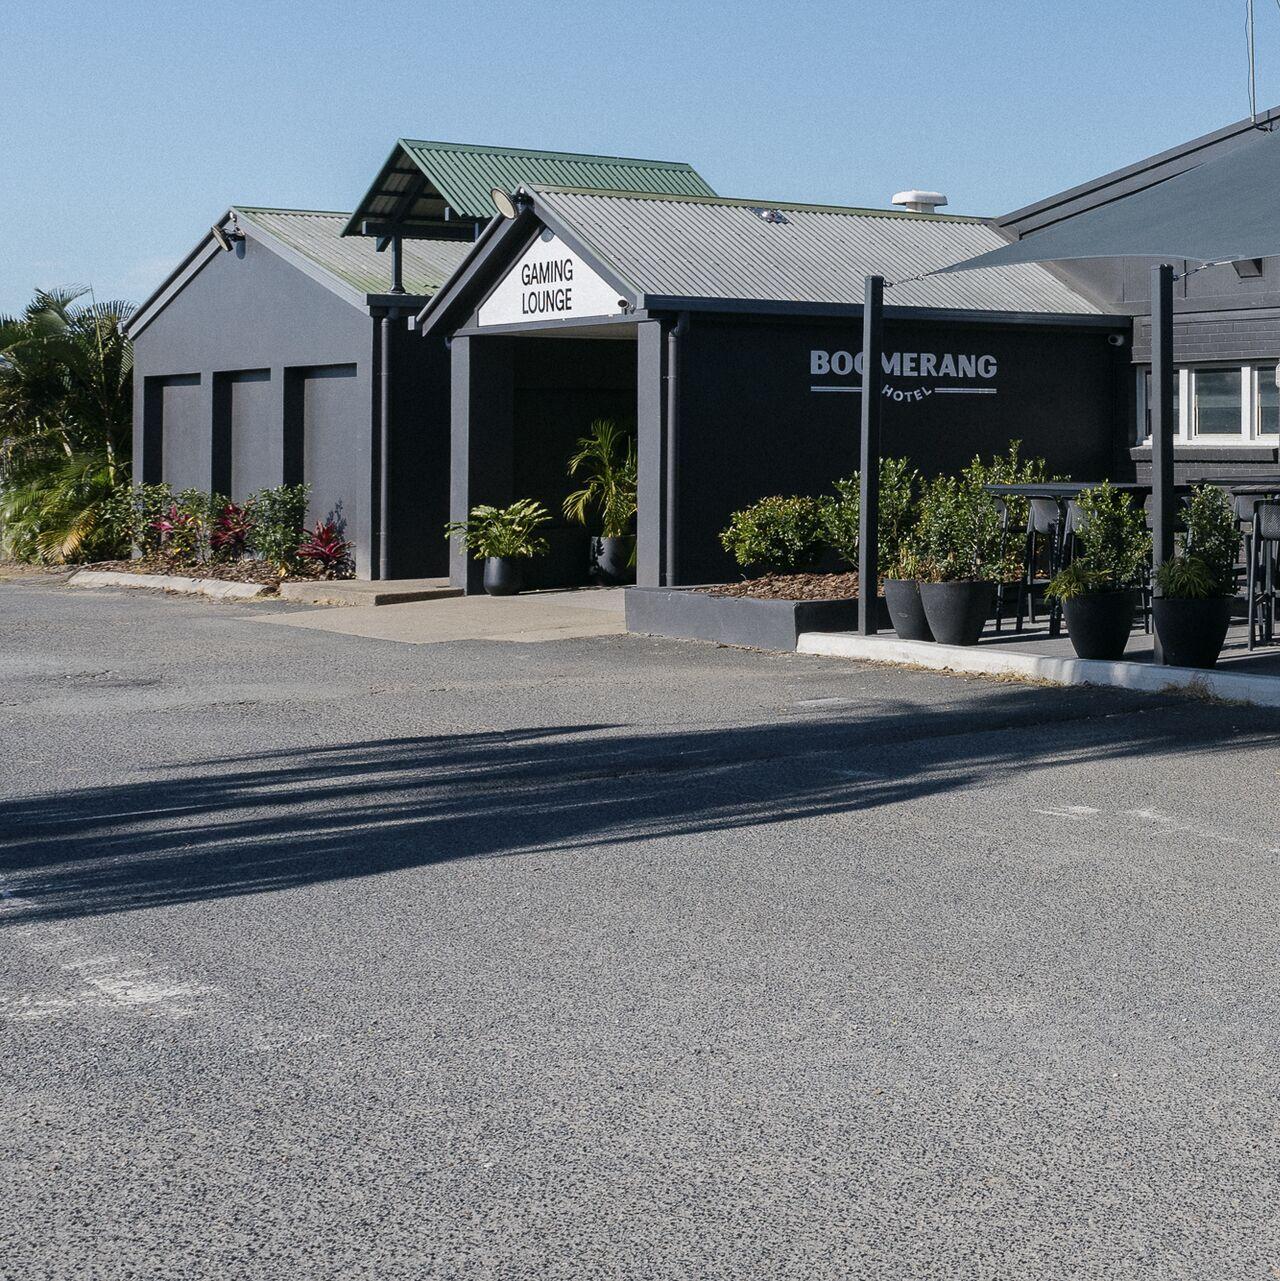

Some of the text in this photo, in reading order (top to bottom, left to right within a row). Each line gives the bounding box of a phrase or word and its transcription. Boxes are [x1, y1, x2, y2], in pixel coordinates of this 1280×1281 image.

[521, 259, 573, 286] GAMING
[522, 288, 572, 314] LOUNGE
[881, 384, 932, 402] HOTEL
